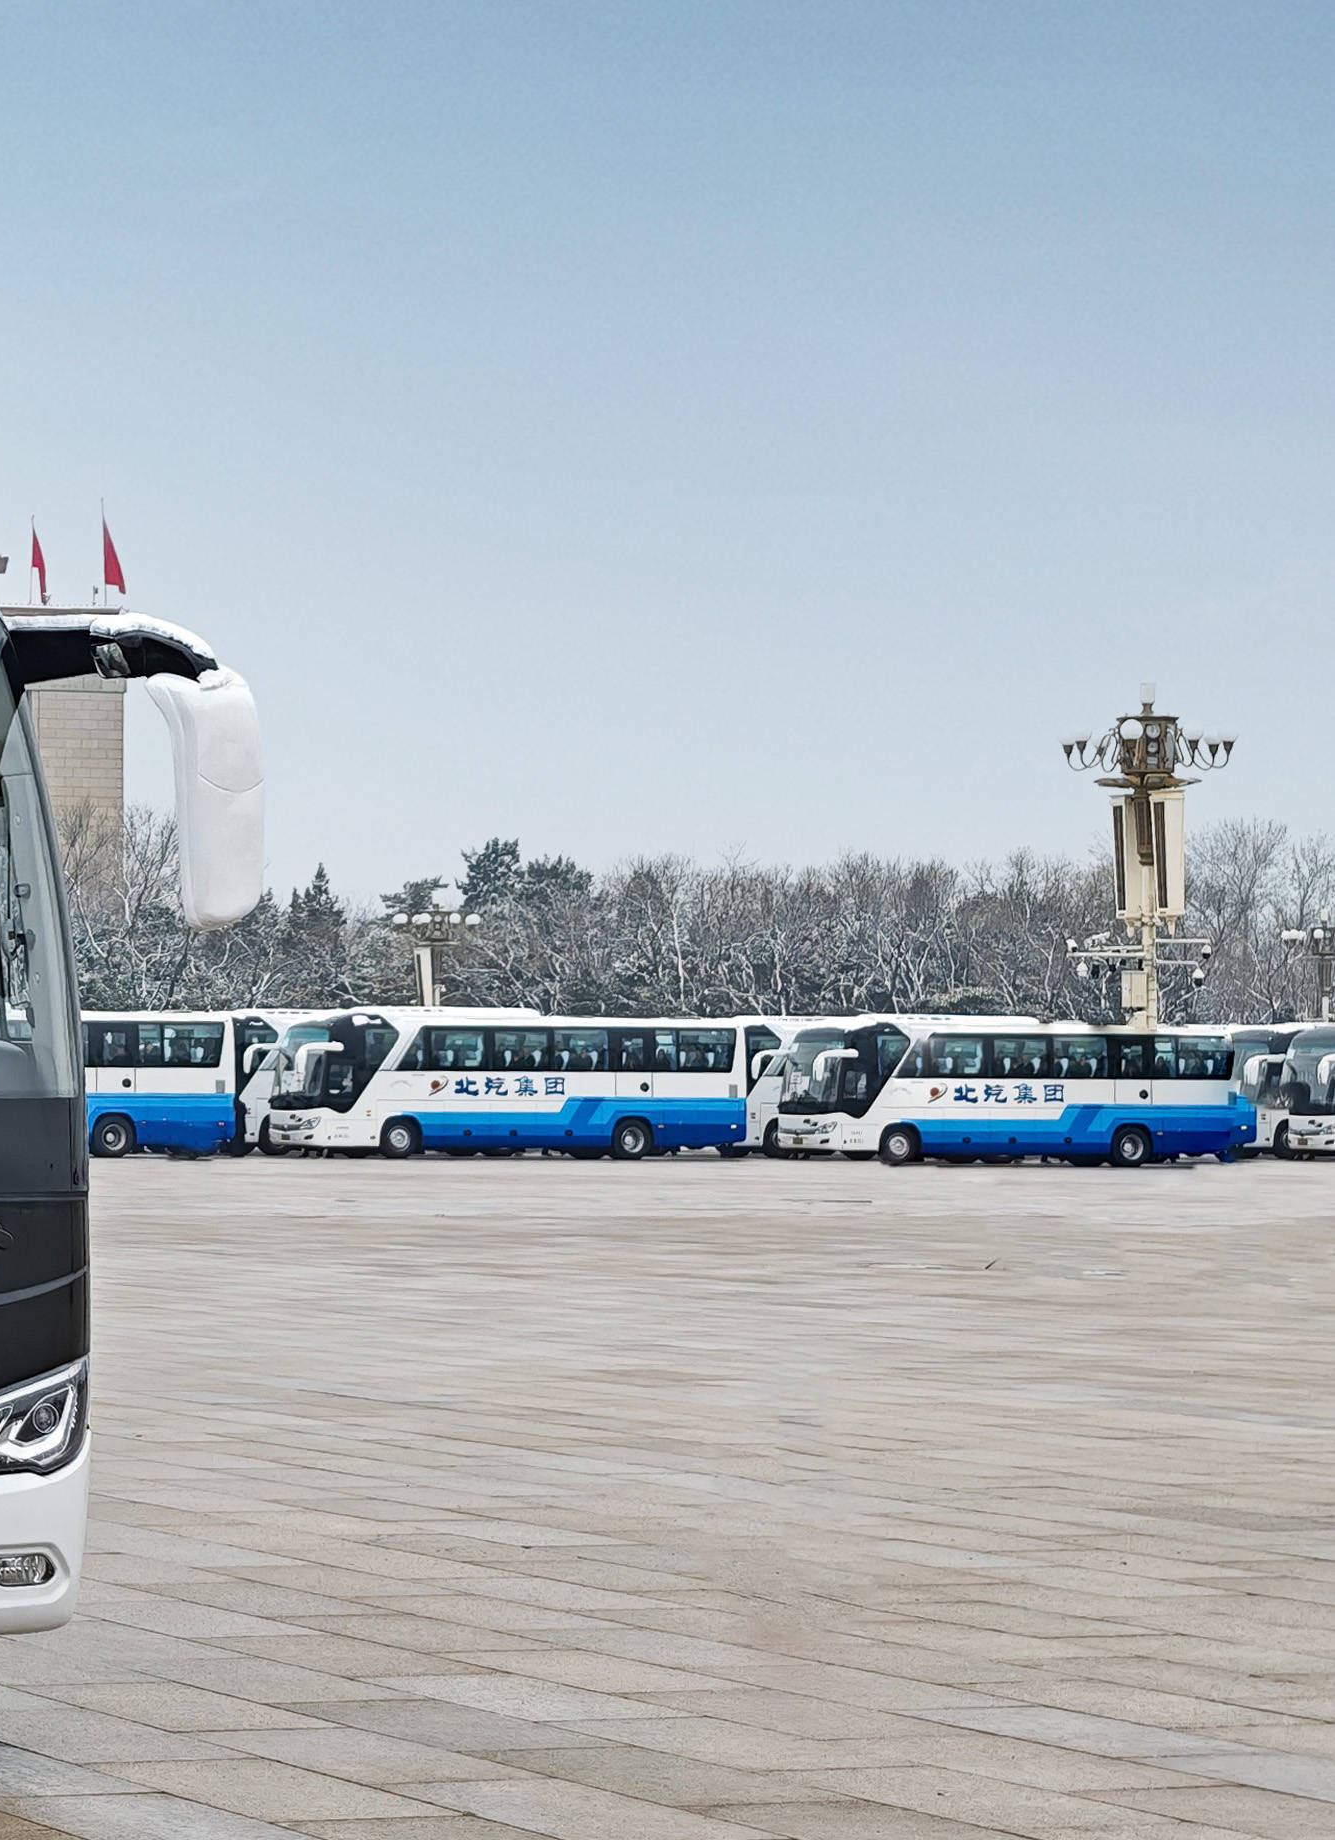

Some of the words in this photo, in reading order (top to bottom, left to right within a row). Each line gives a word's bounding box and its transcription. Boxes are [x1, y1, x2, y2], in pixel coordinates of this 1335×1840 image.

[454, 1075, 566, 1097] 北汽集团
[953, 1083, 1065, 1105] 北汽集团
